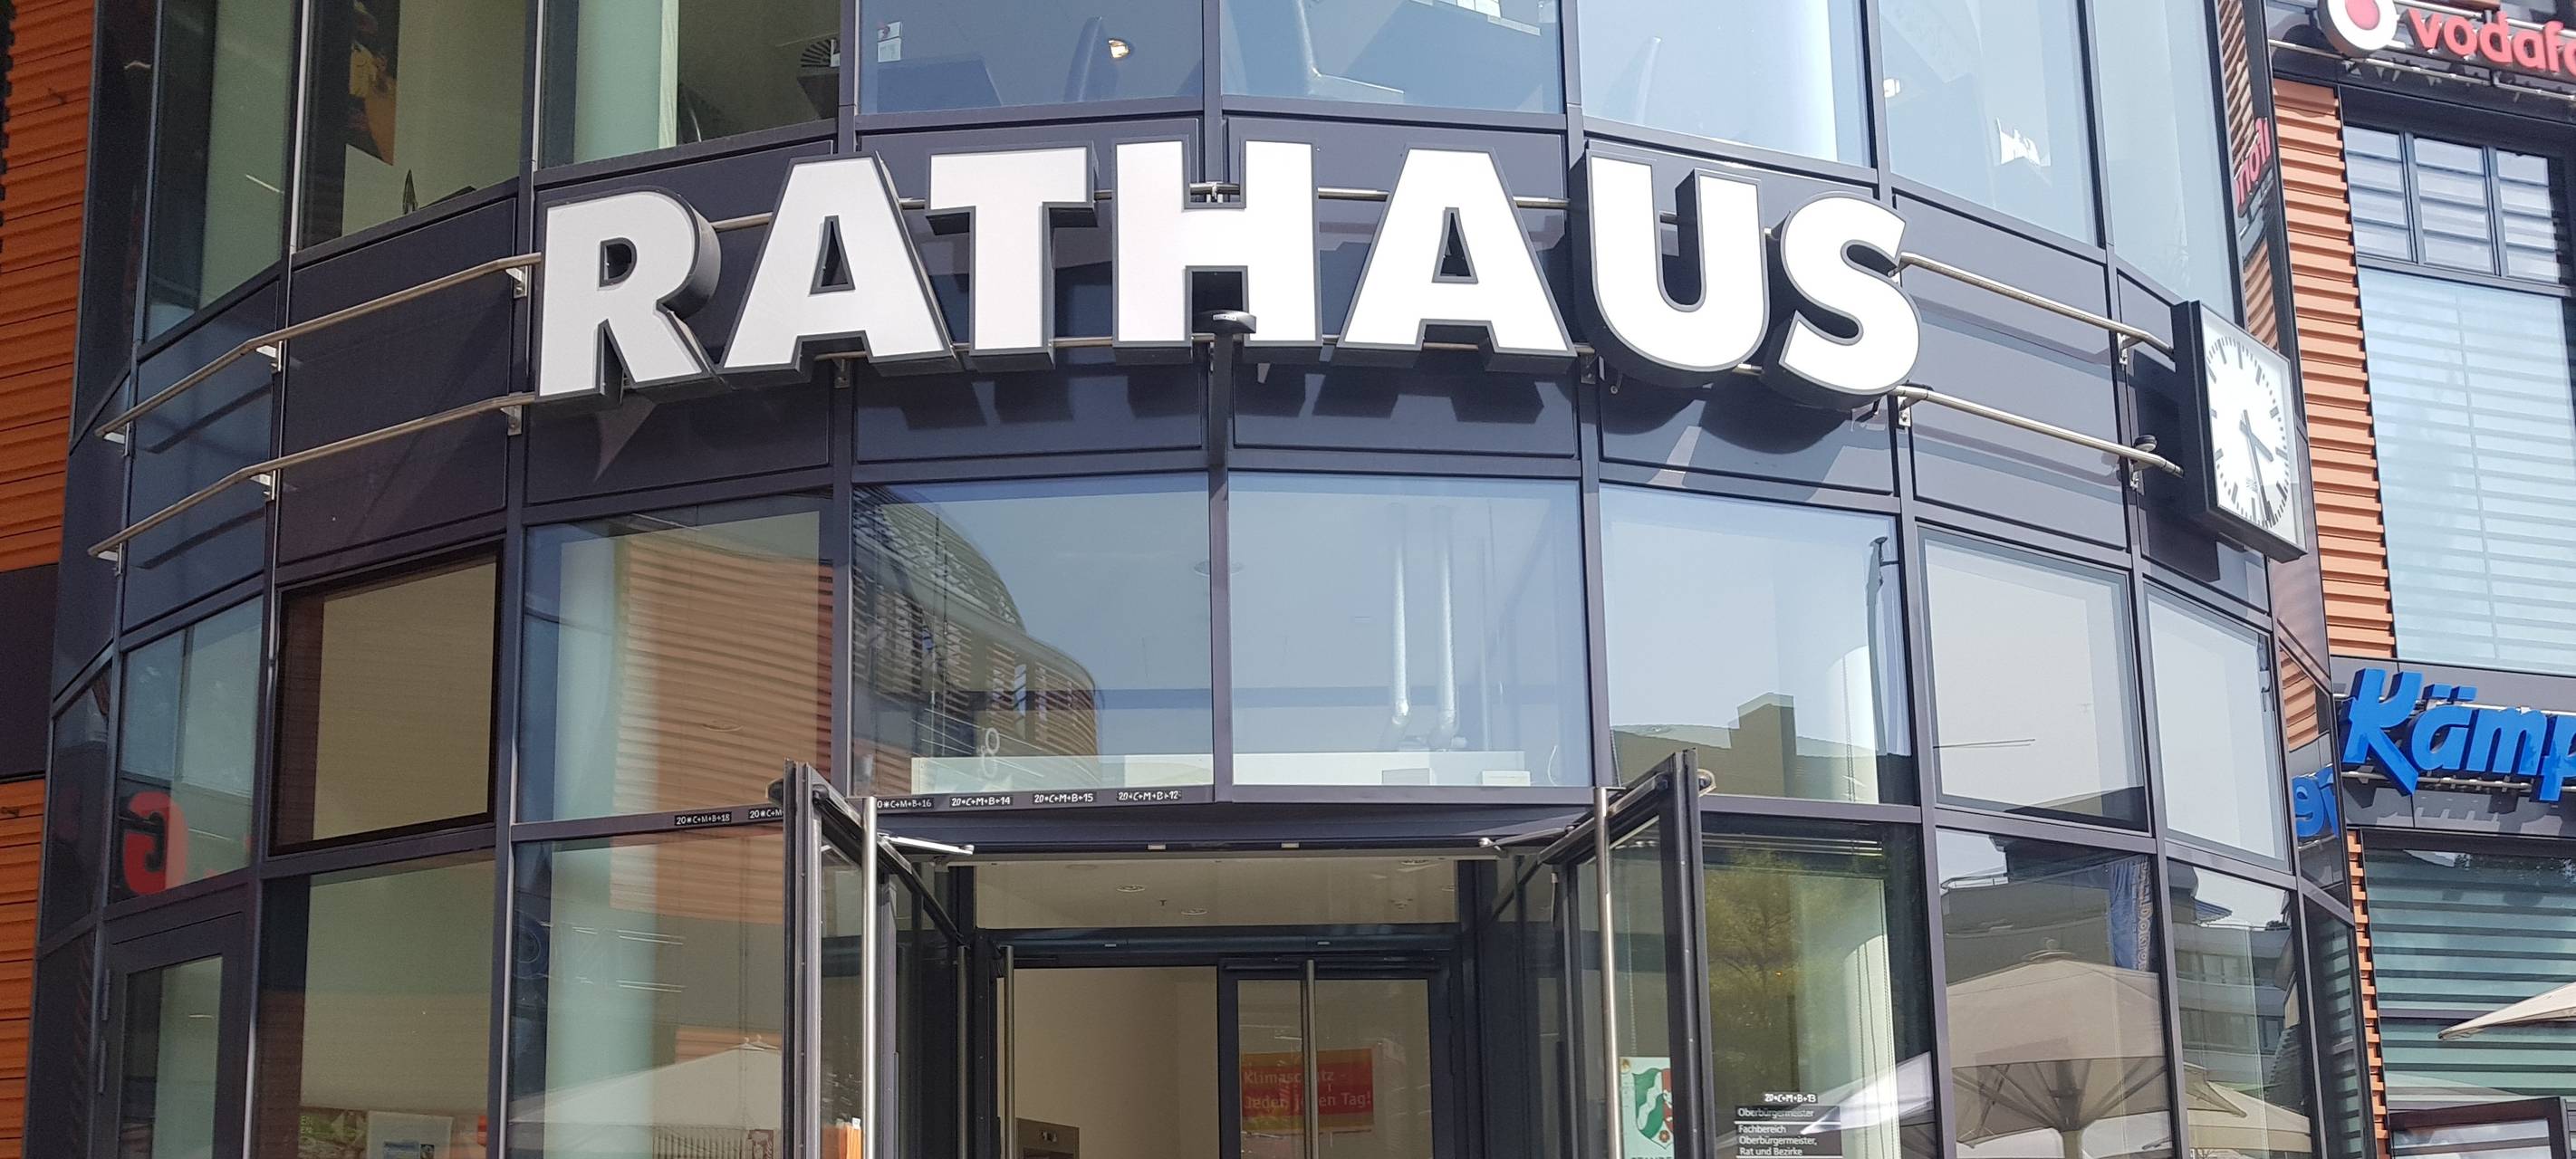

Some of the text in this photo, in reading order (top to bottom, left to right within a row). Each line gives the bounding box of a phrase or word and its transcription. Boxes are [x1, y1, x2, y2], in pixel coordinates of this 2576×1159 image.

[535, 136, 1921, 401] RATHAUS
[1341, 1091, 1371, 1107] Tag!
[1738, 1107, 1815, 1118] Oberbürgermeister
[1738, 1125, 1787, 1134] Fachbereich
[1739, 1135, 1818, 1146] Oberbürgermeister,
[1739, 1146, 1803, 1155] Rat und Bezirke
